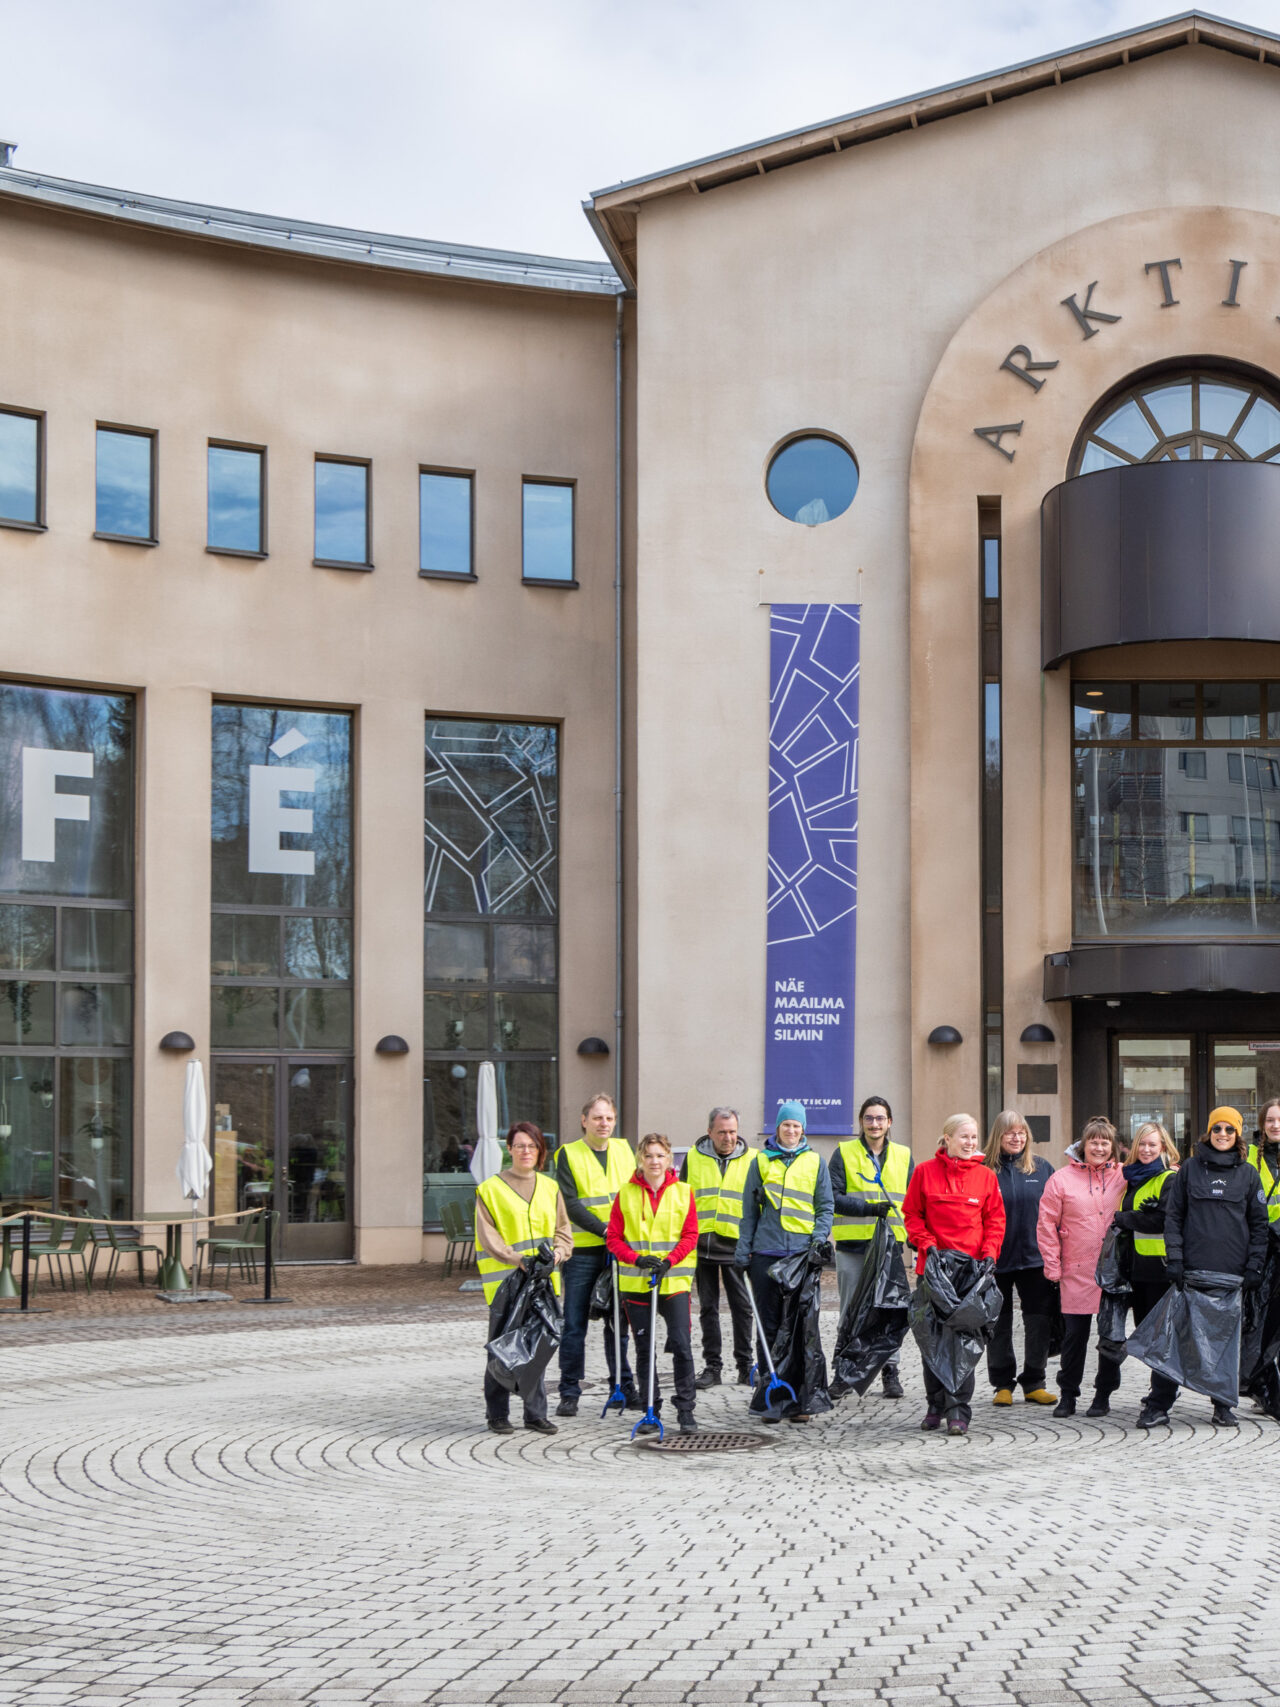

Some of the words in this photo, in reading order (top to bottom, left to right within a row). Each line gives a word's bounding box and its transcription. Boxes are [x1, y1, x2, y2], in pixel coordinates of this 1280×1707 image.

[775, 977, 805, 993] NÄE
[774, 997, 845, 1009] MAAILMA
[774, 1013, 840, 1025] ARKTISIN
[774, 1029, 823, 1041] SILMIN
